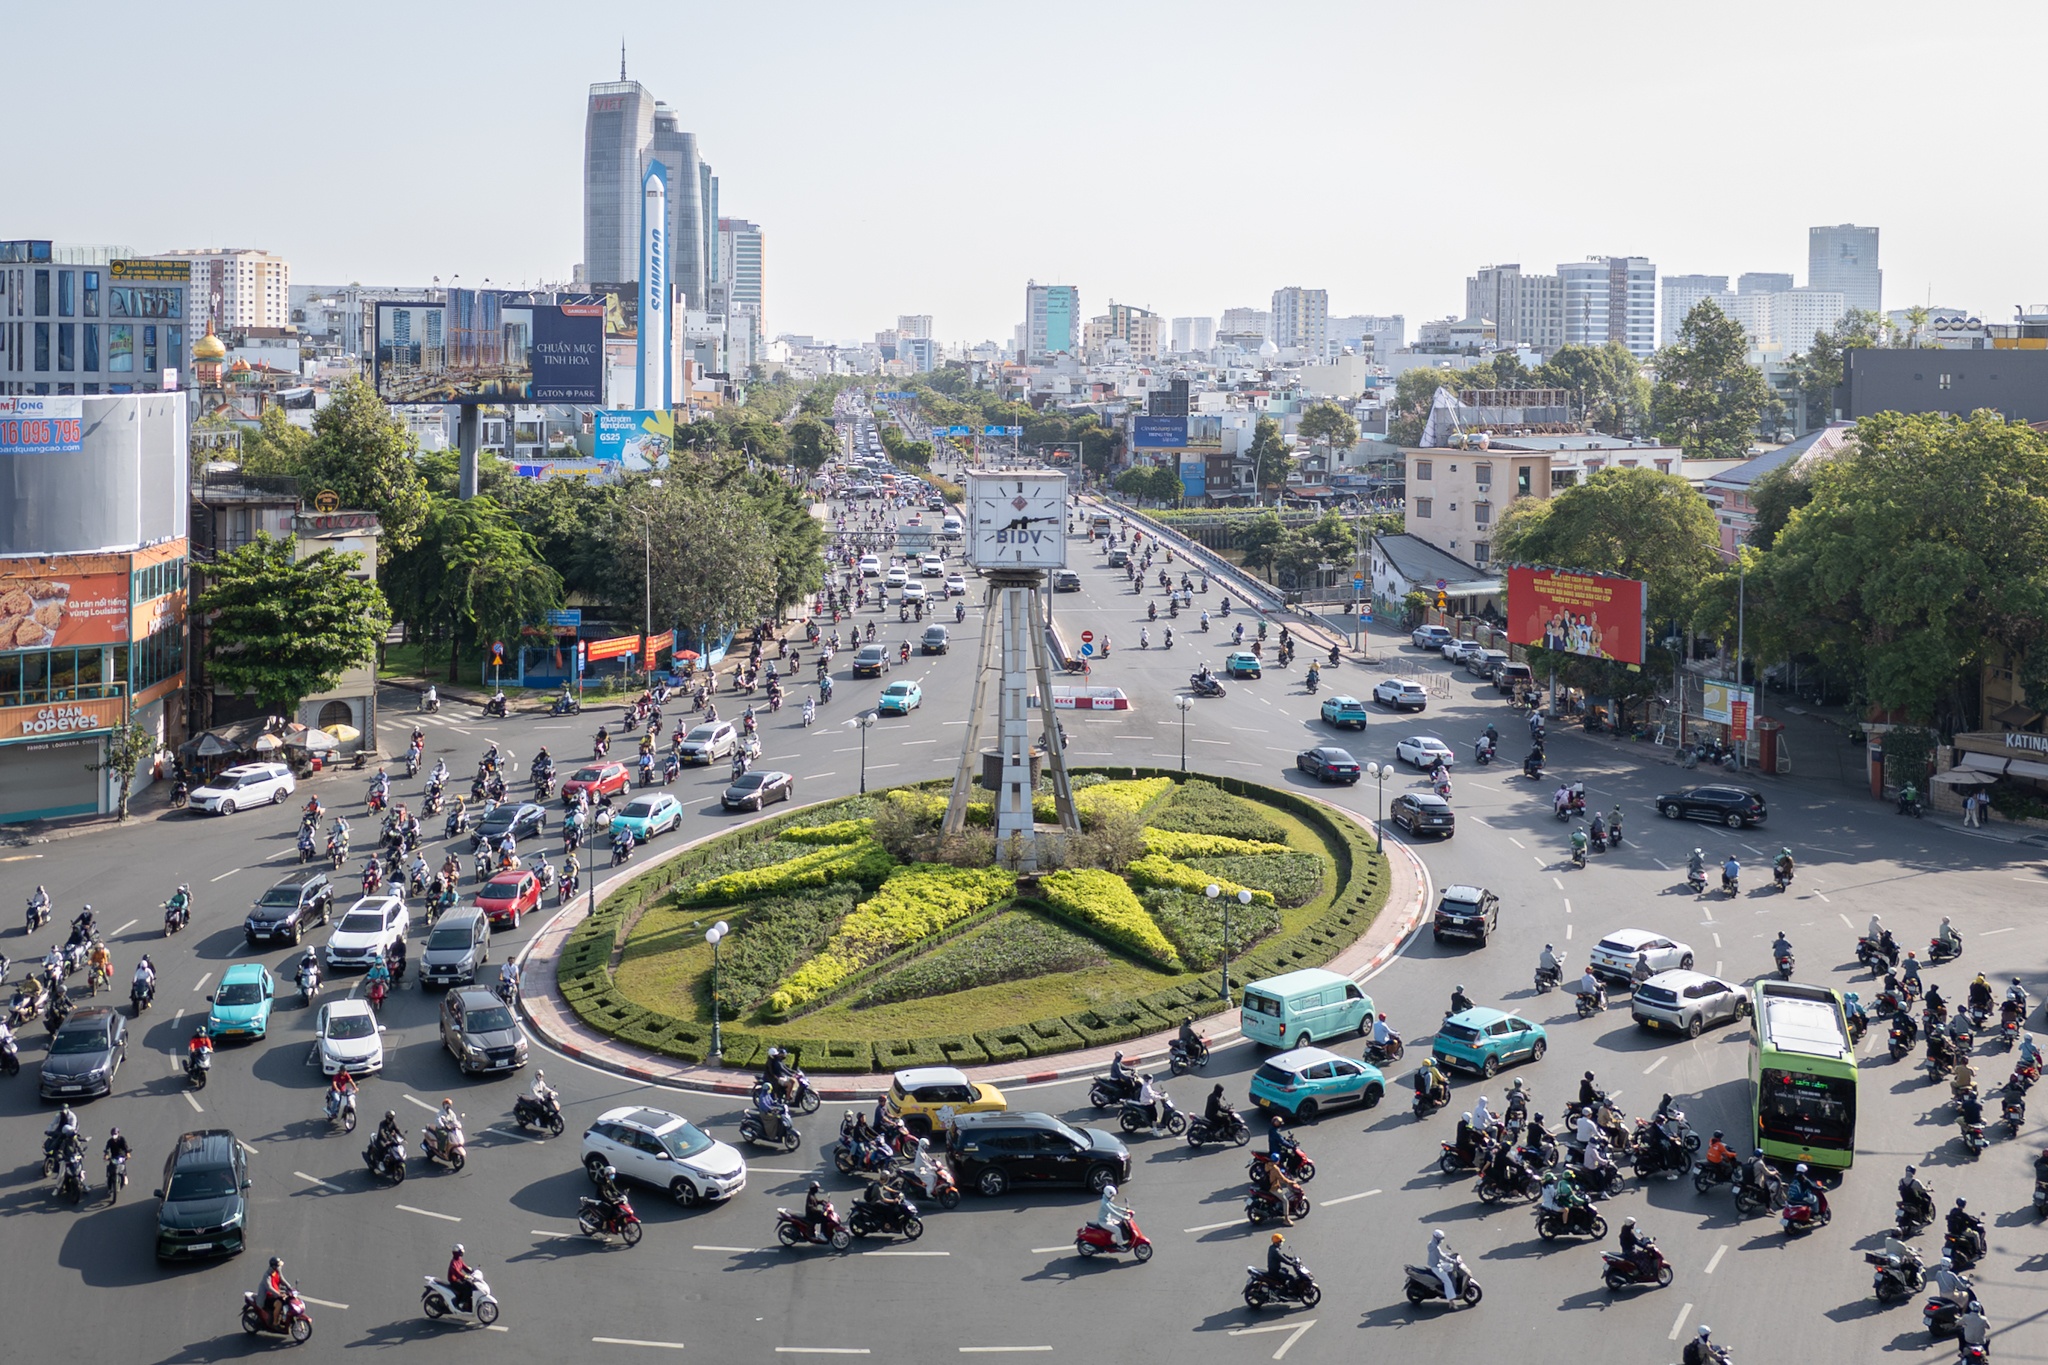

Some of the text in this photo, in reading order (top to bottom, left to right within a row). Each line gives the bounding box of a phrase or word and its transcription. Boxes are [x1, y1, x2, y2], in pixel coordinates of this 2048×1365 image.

[543, 356, 590, 365] TINH HOA
[22, 420, 50, 444] 095
[54, 419, 81, 443] 795
[600, 433, 620, 441] GS25
[996, 530, 1042, 544] BIDV
[68, 599, 79, 609] Gà
[80, 599, 94, 608] rán
[69, 607, 127, 618] vùng Louisiana
[38, 703, 82, 719] GÀ RÁN
[52, 741, 80, 749] LOUISIANA
[2006, 733, 2048, 752] KATINA
